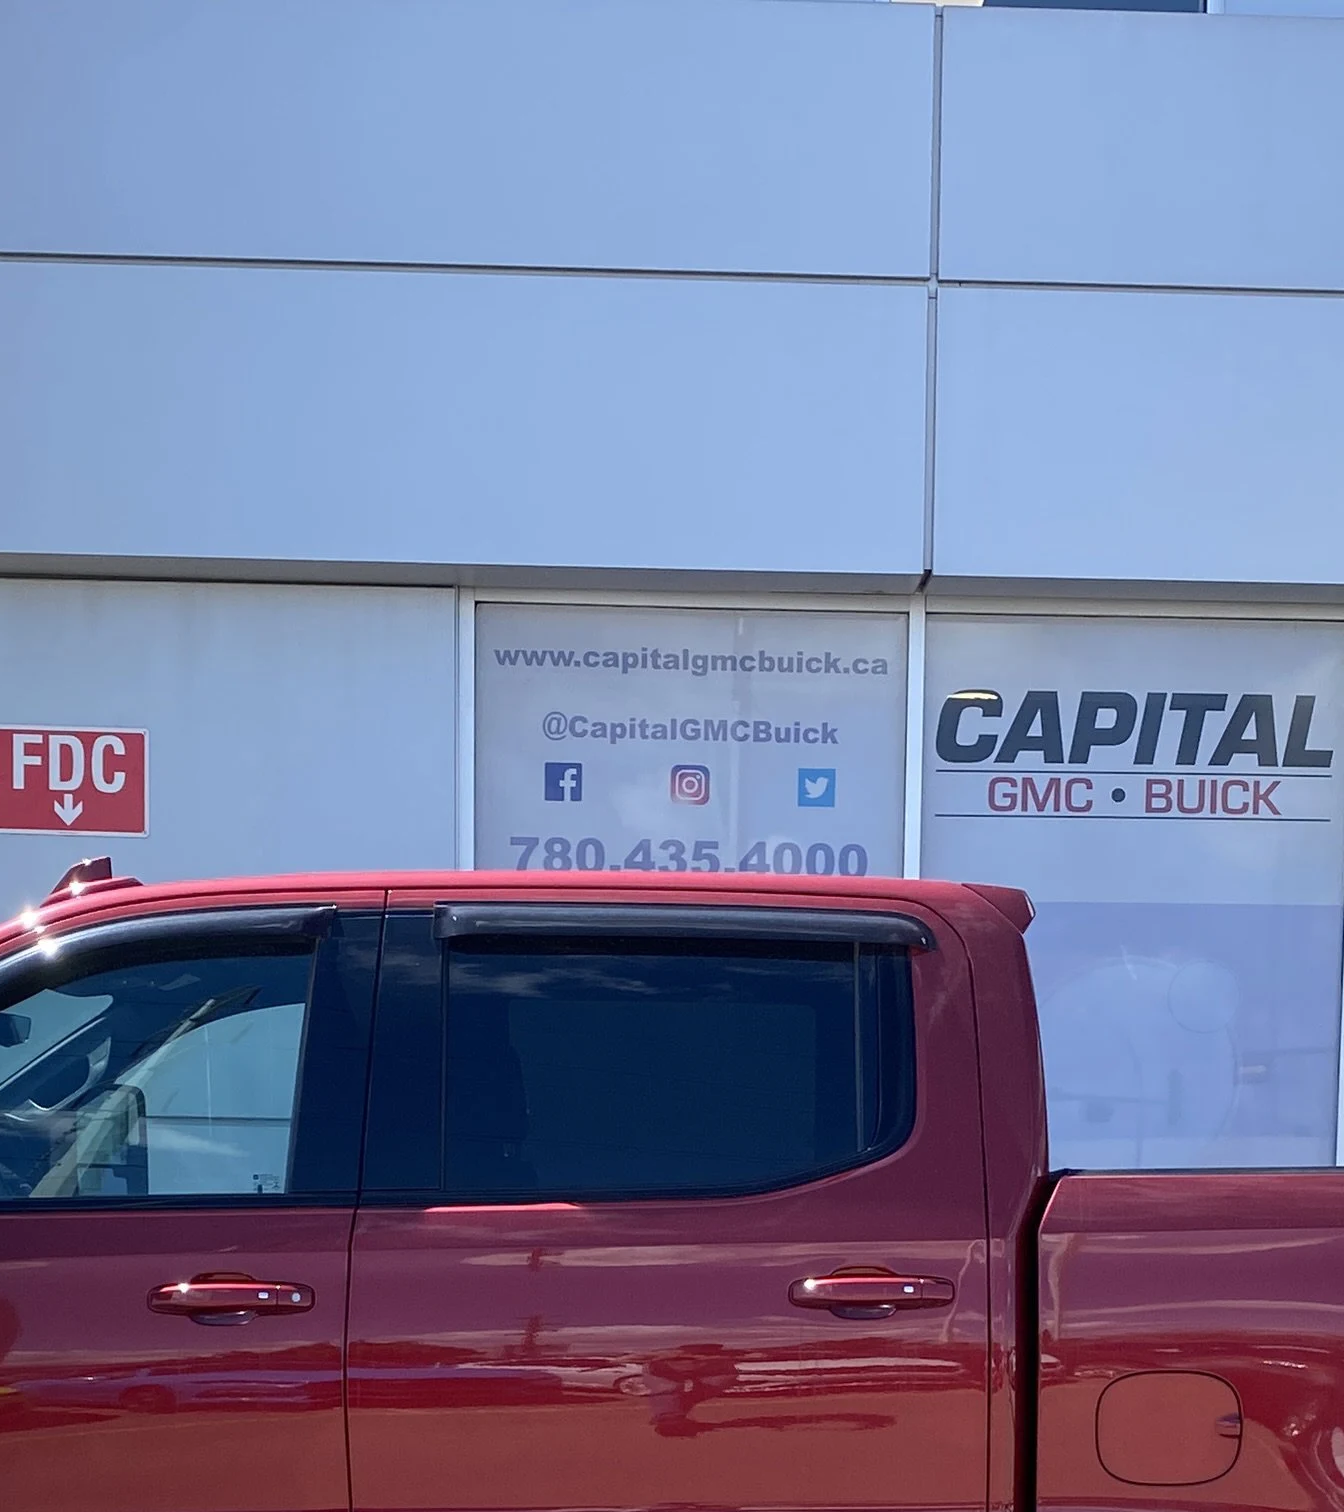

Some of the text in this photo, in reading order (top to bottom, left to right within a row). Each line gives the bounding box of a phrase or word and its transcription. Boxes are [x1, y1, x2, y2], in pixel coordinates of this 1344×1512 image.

[494, 647, 889, 676] www.capitalgmcbuick.ca
[542, 711, 839, 745] @CapitalGMCBuick
[935, 690, 1334, 768] CAPITAL
[12, 733, 126, 793] FDC
[987, 777, 1283, 816] GMC BUICK
[509, 836, 869, 877] 780.435.4000
